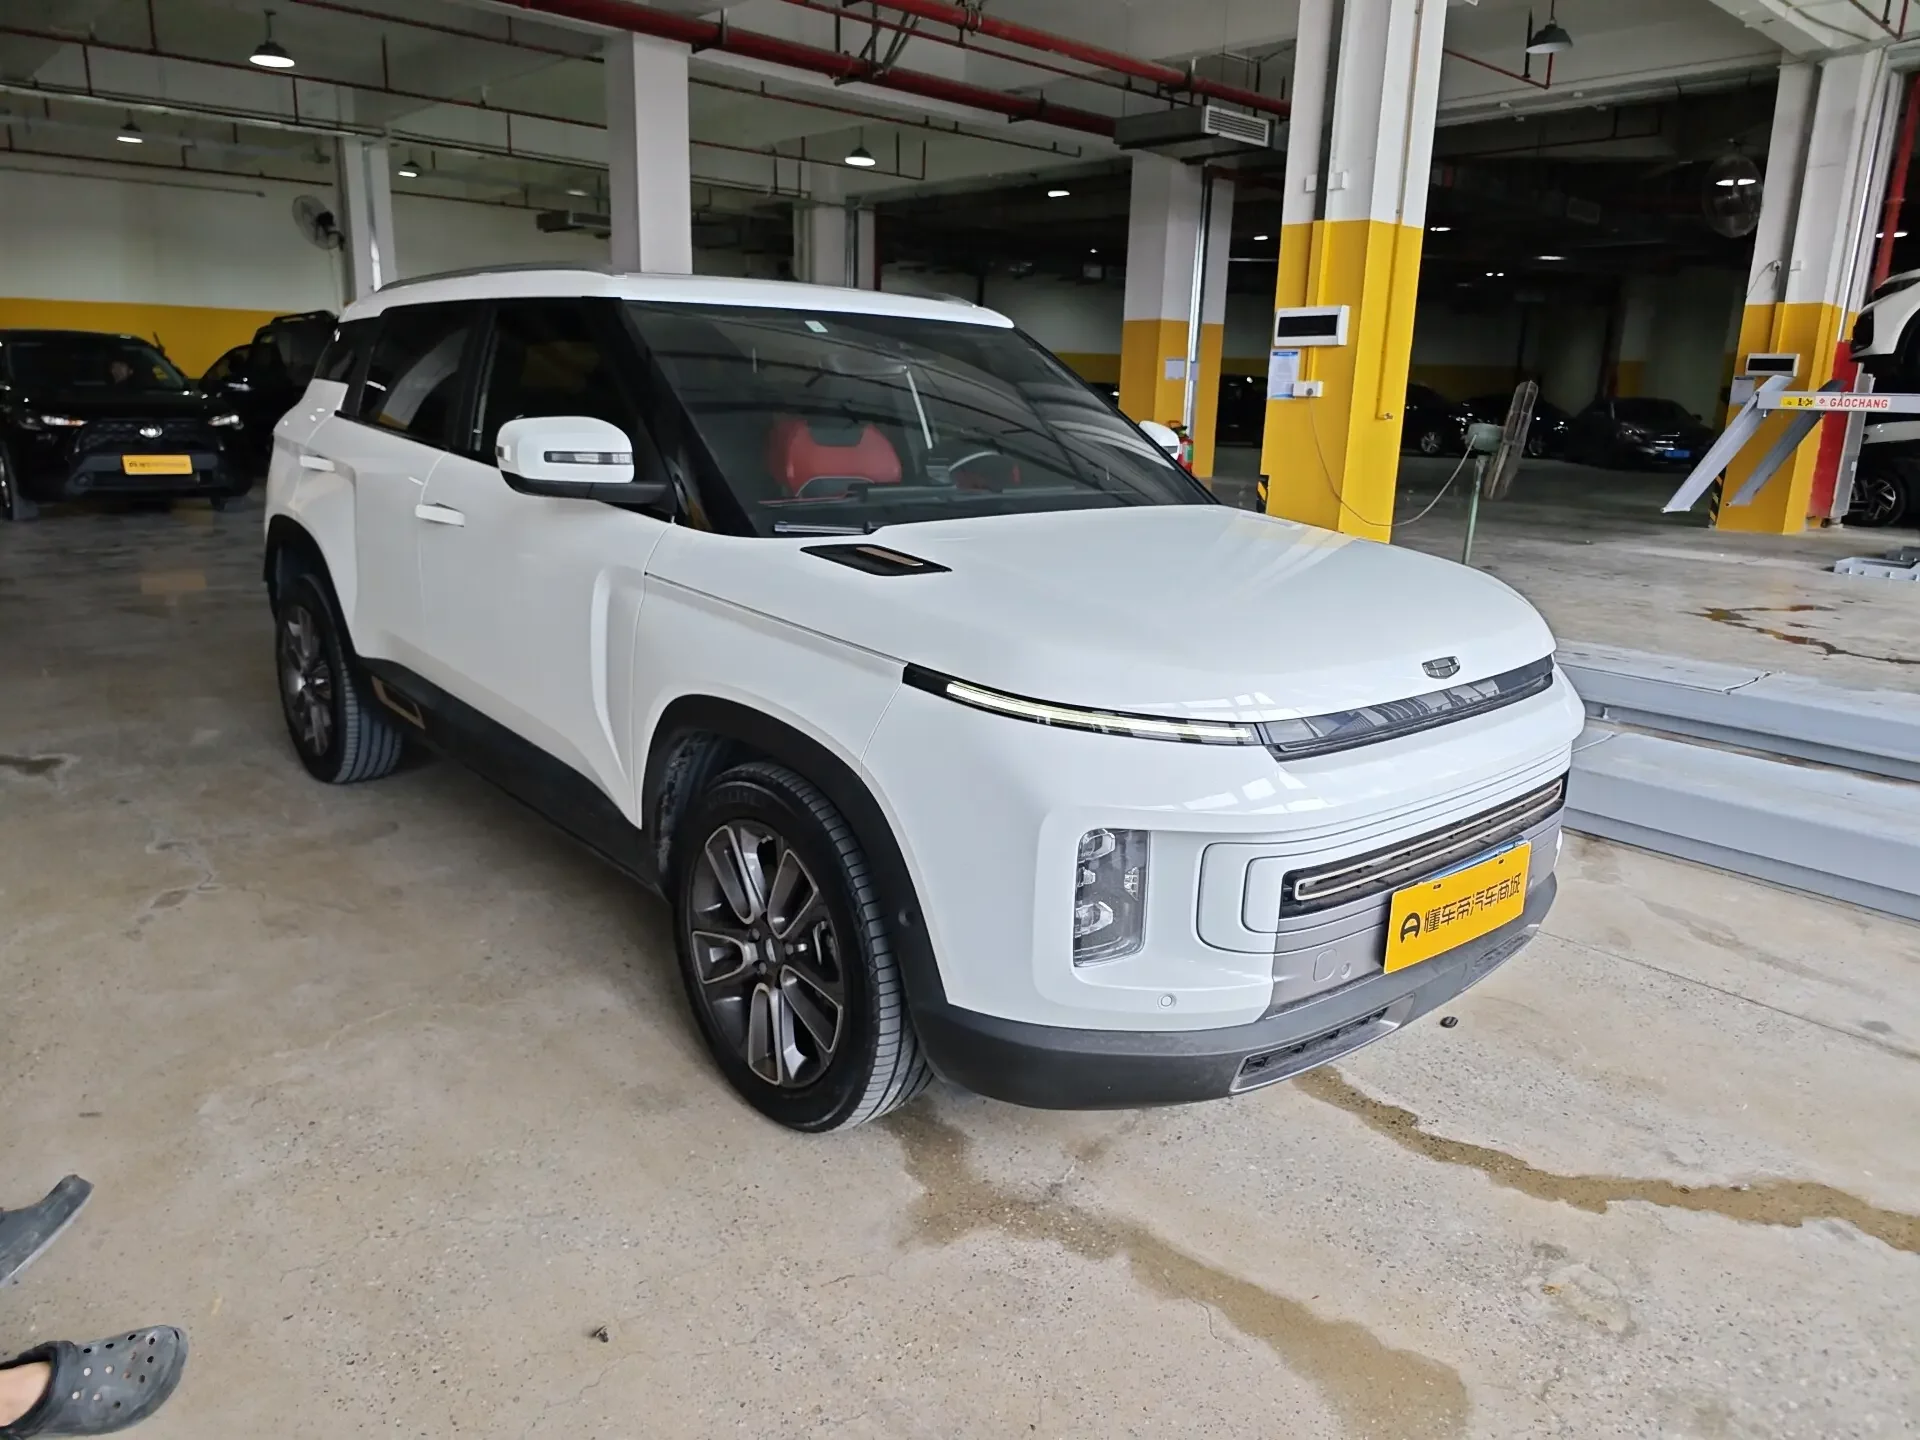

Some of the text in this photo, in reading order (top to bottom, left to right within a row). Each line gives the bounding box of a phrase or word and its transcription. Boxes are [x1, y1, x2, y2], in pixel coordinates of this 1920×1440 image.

[1829, 398, 1888, 408] GAOCHANG
[1424, 872, 1521, 933] 懂车帝汽车商城
